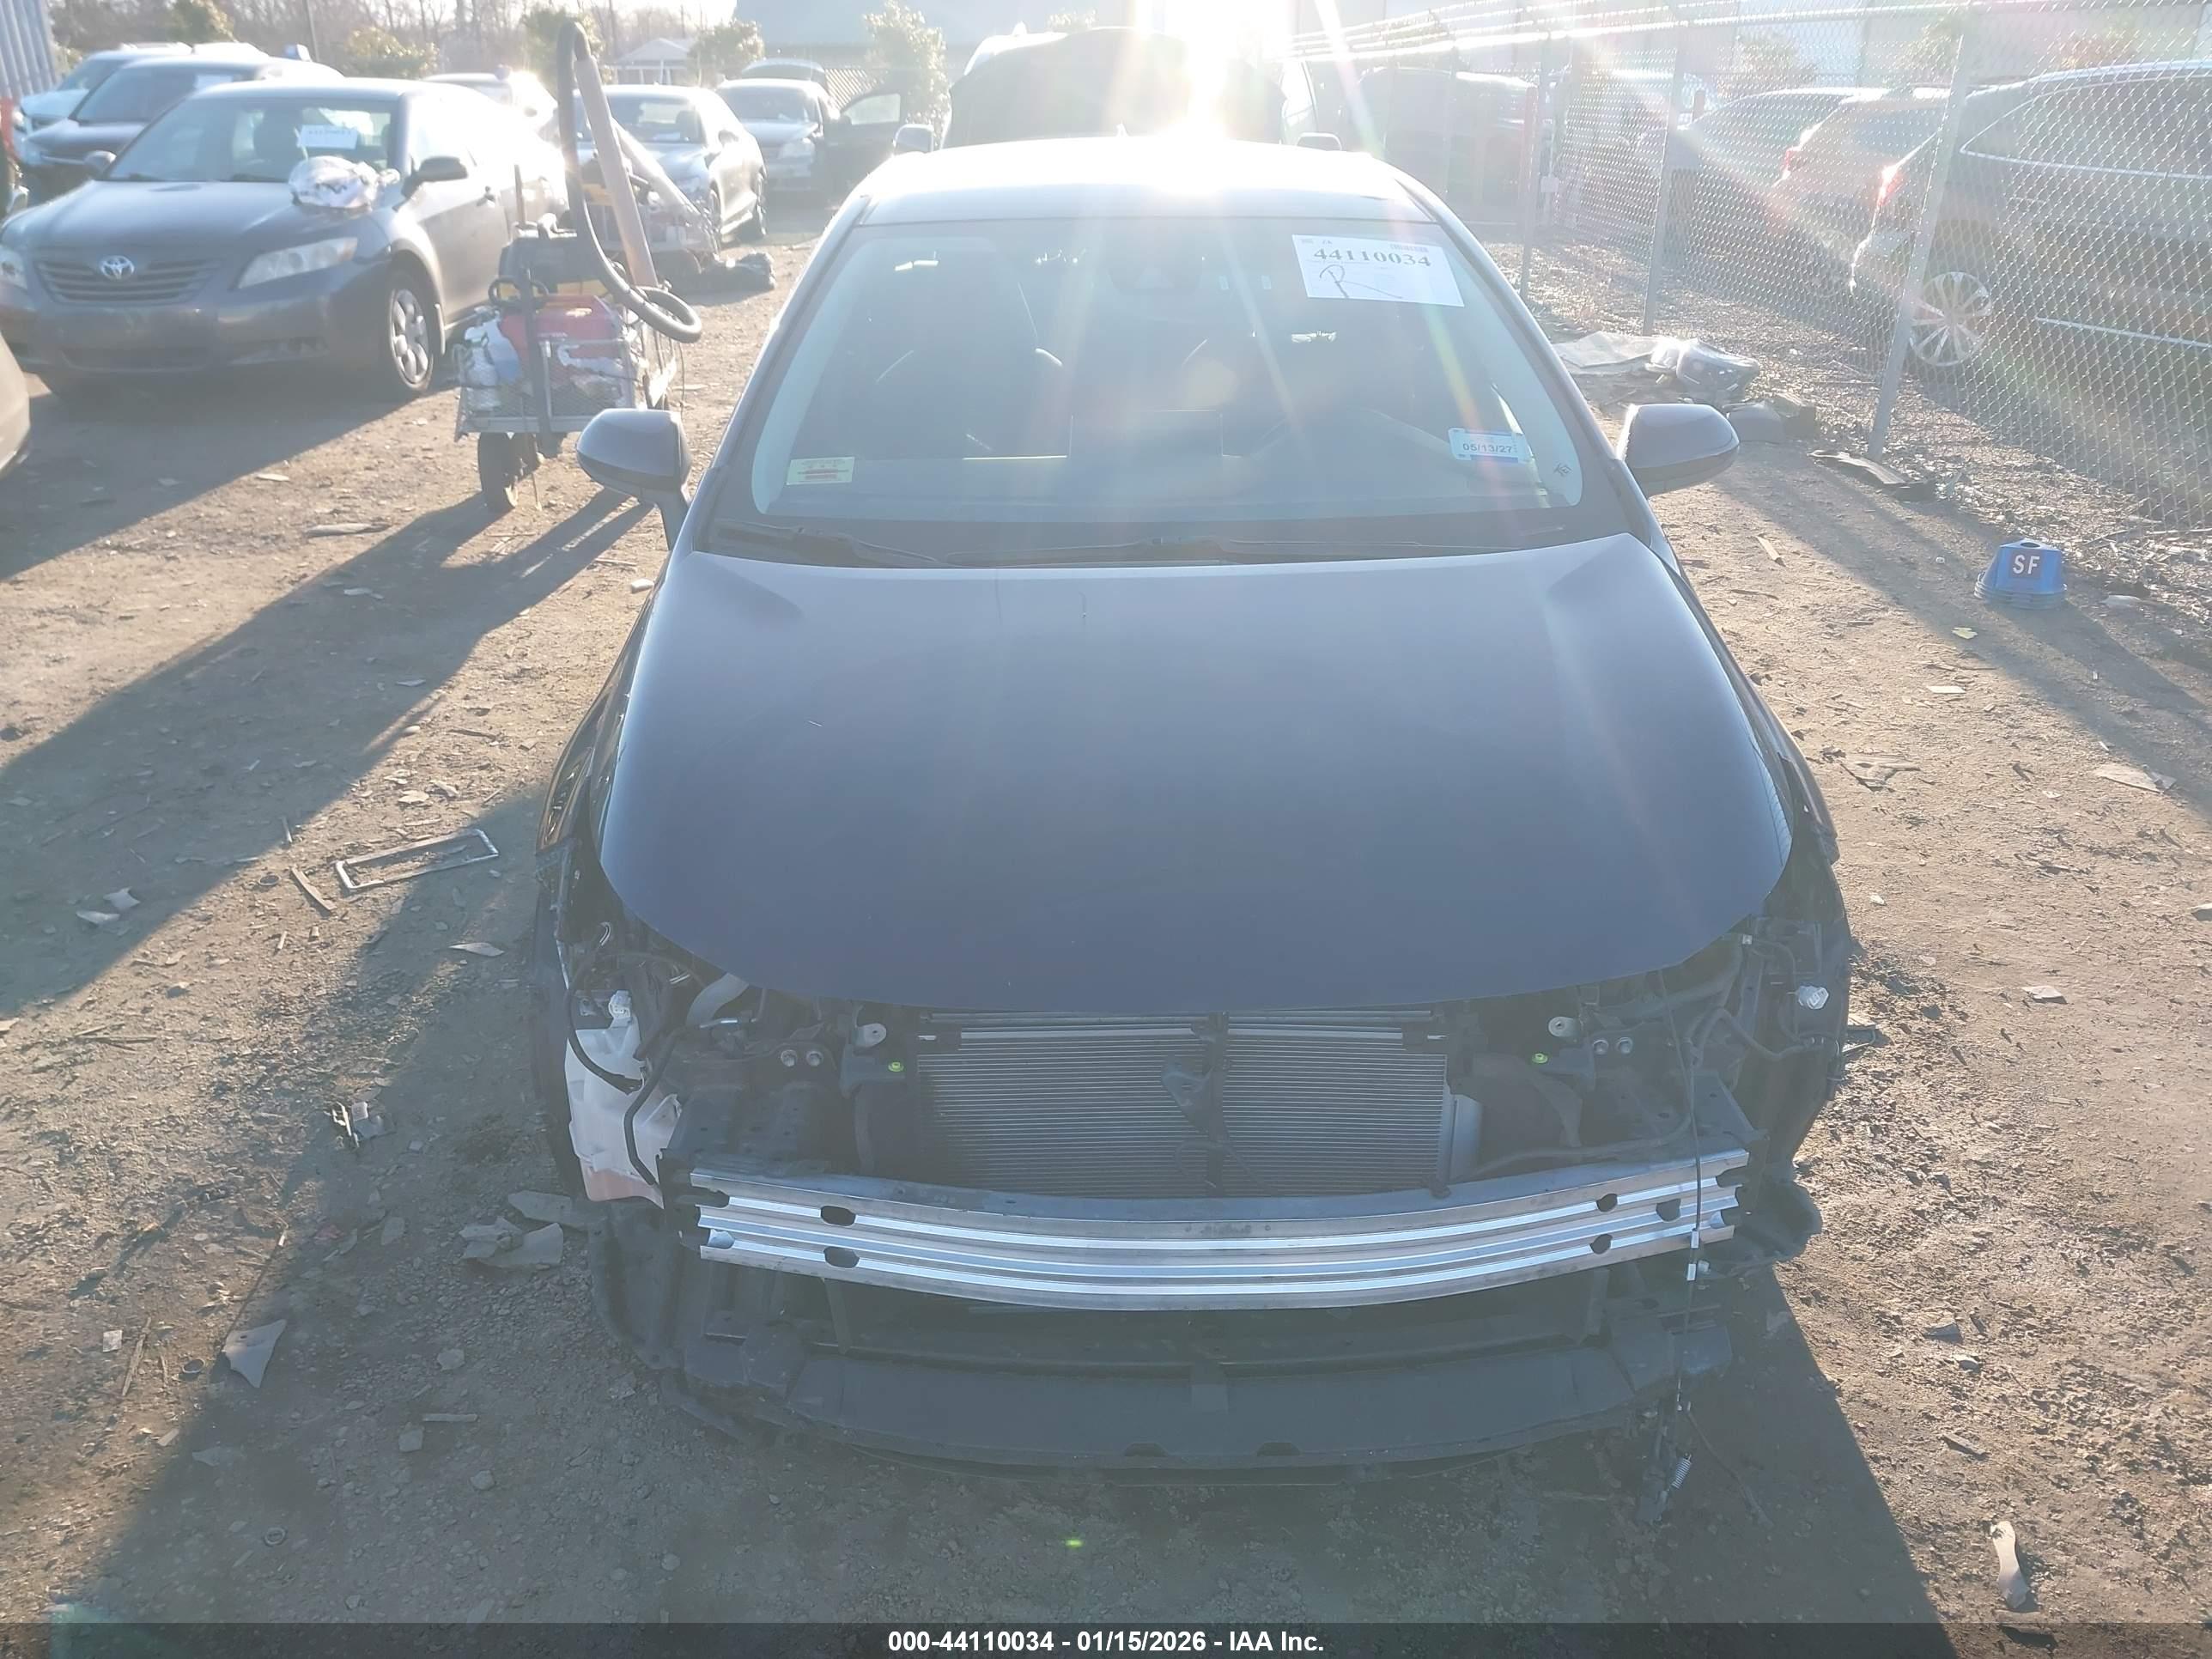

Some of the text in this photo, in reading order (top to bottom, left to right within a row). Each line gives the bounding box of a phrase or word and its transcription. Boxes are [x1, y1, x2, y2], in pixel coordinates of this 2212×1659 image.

[1314, 248, 1431, 267] 44110034
[1462, 442, 1512, 454] 05/13/27
[2012, 554, 2041, 574] SF
